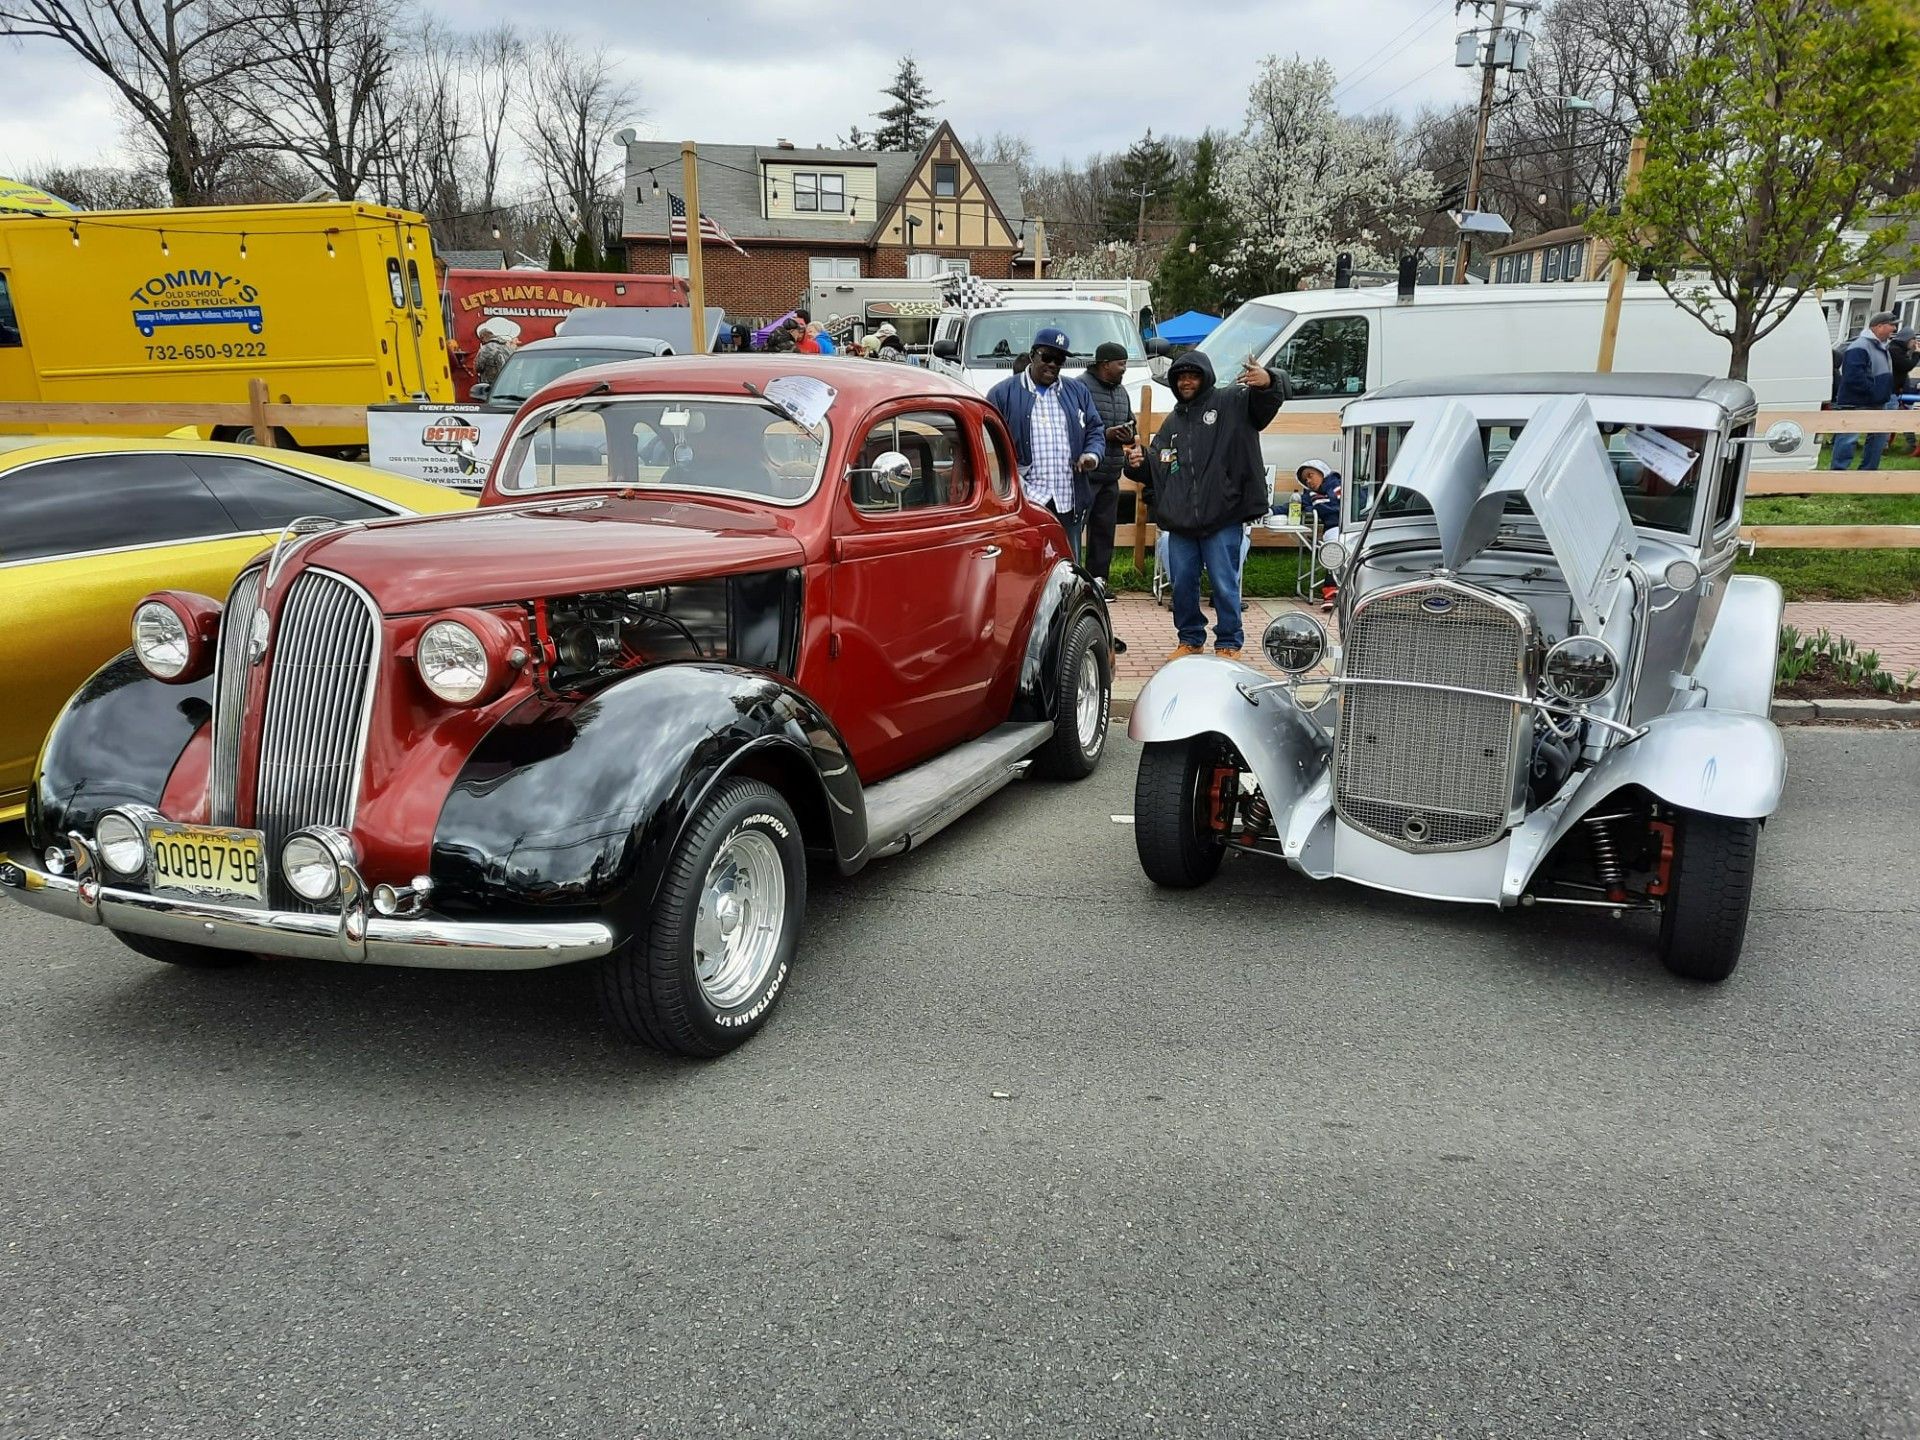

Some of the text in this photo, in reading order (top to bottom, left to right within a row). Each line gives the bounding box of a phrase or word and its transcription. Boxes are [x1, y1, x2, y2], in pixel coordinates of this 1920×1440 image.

[130, 269, 258, 305] TOMMY'S
[165, 289, 223, 299] OLD SCHOOL
[460, 288, 500, 310] LET'S
[502, 285, 544, 301] HAVE
[547, 287, 559, 301] A
[154, 297, 238, 308] FOOD TRUCK
[484, 307, 528, 316] RICEBALLS
[529, 308, 536, 316] &
[144, 342, 267, 361] 732-650-9222
[426, 427, 478, 441] BC TIRE
[741, 813, 789, 839] THOMPSON
[155, 841, 258, 884] QQ88798
[714, 961, 787, 1027] SPORTSMAN S/T
